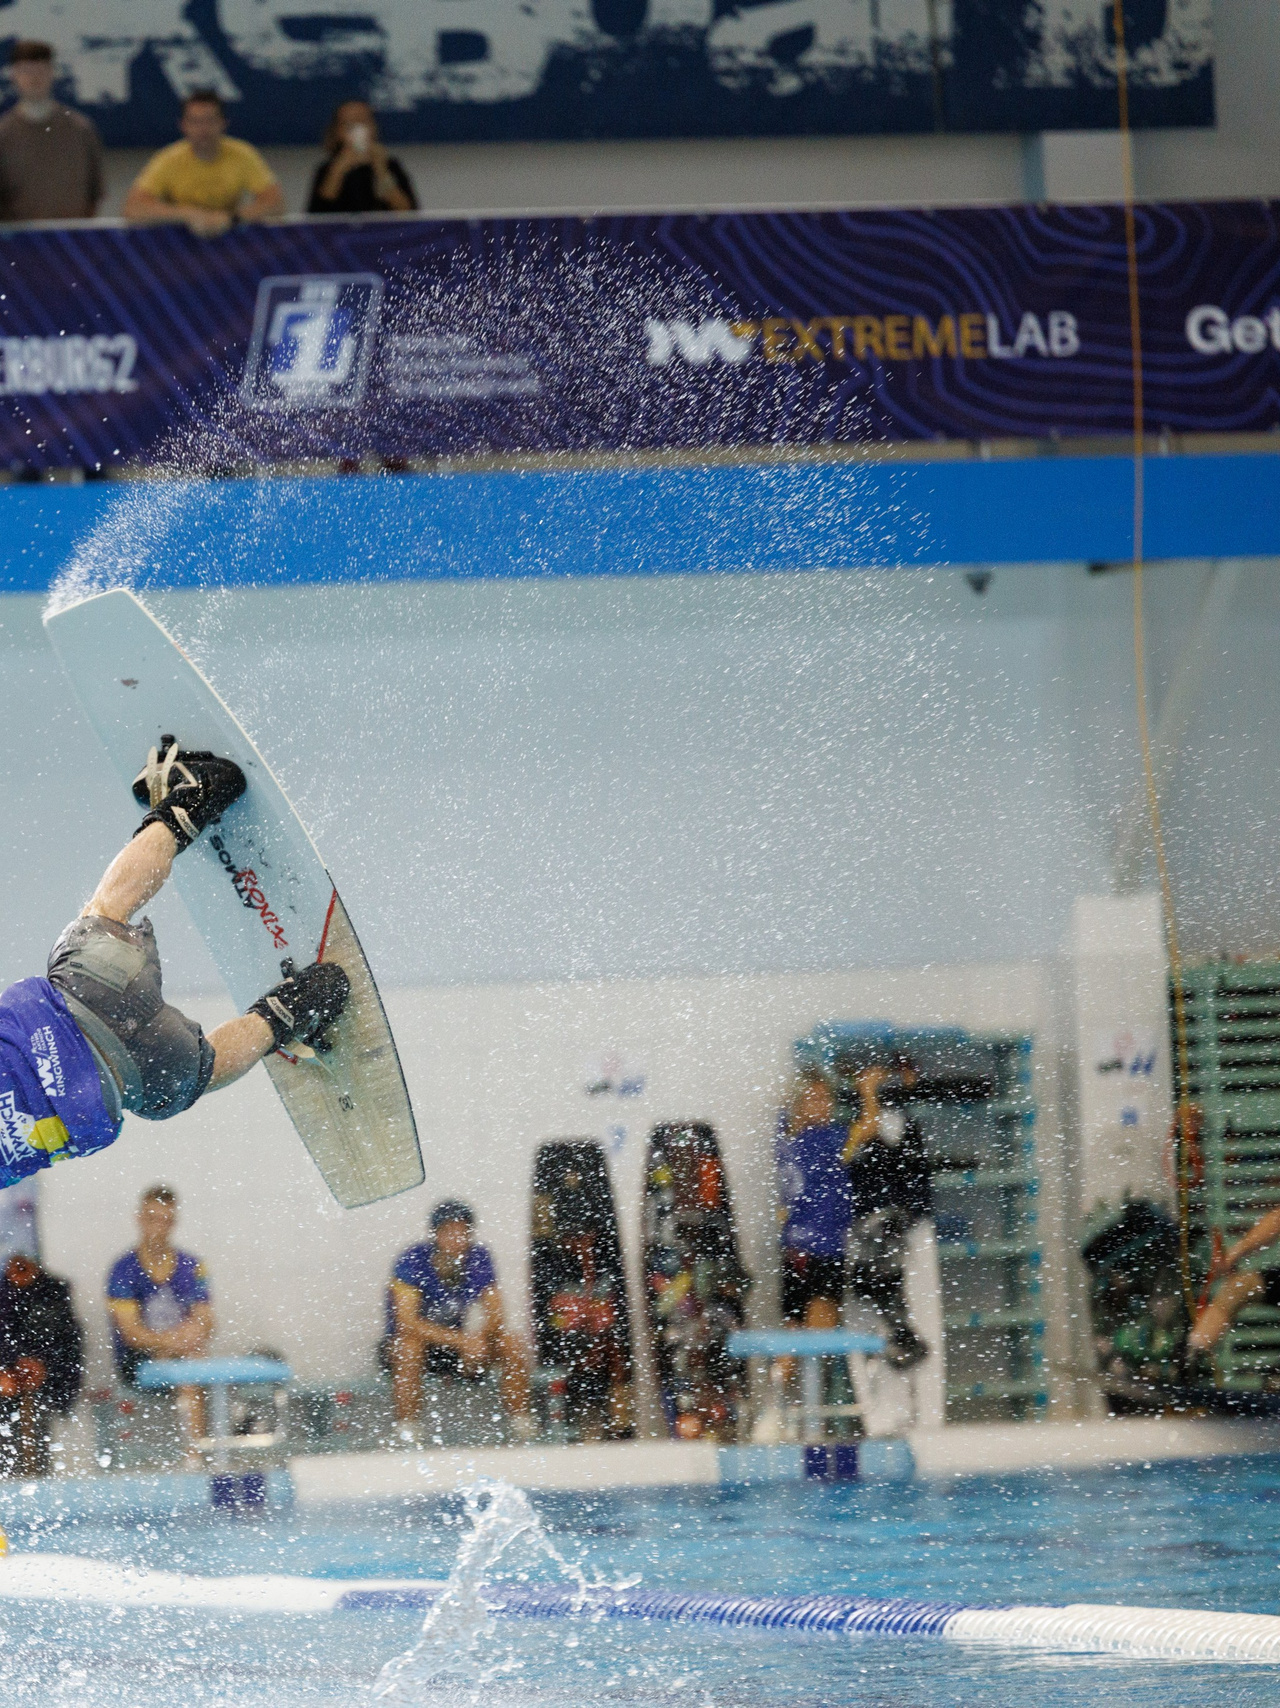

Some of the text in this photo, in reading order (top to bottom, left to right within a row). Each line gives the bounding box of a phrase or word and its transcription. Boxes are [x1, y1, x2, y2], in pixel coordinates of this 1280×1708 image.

[761, 311, 1081, 361] EXTREMELAB
[236, 867, 289, 949] RONIX
[42, 1025, 66, 1097] KINGWINCH
